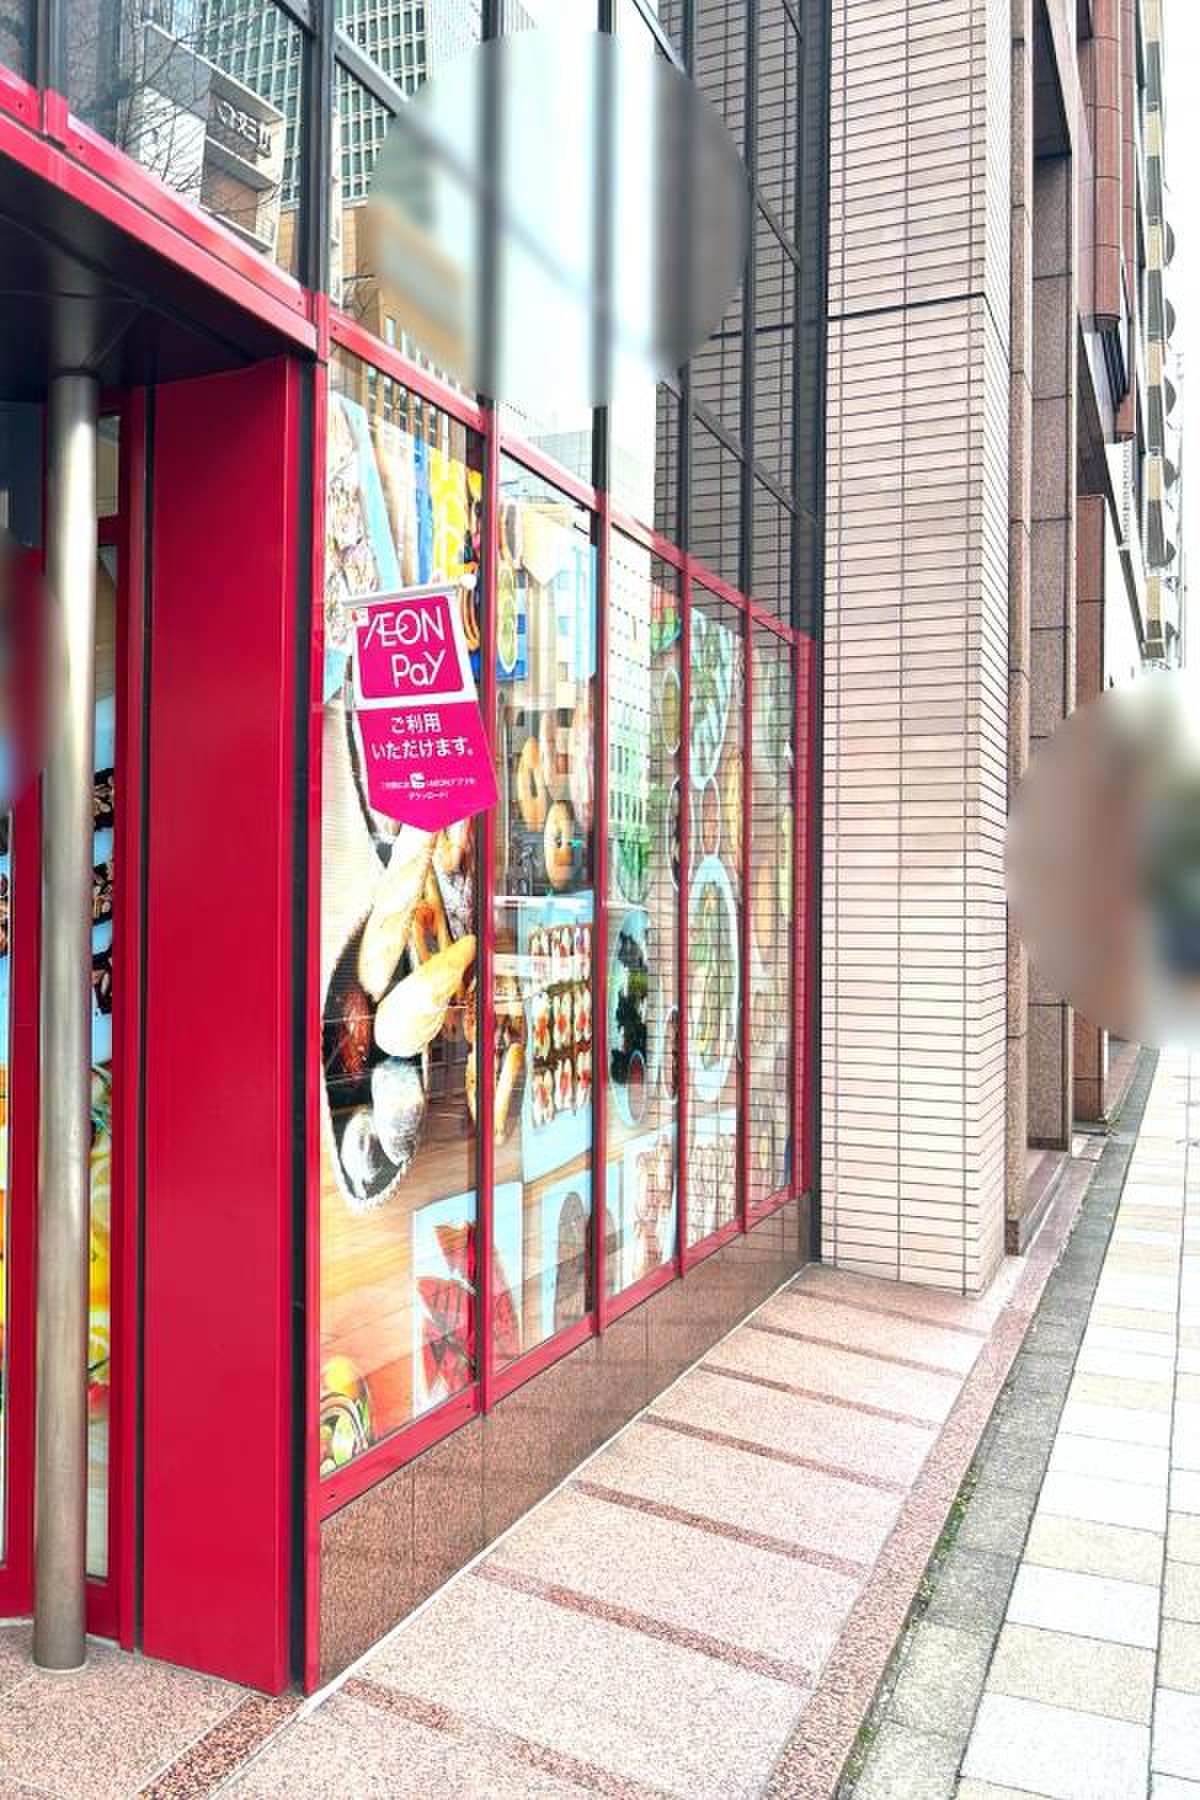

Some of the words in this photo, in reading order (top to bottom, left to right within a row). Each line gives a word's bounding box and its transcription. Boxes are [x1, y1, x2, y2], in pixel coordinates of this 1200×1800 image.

[390, 711, 442, 735] ご利用
[371, 736, 474, 762] いただけます。
